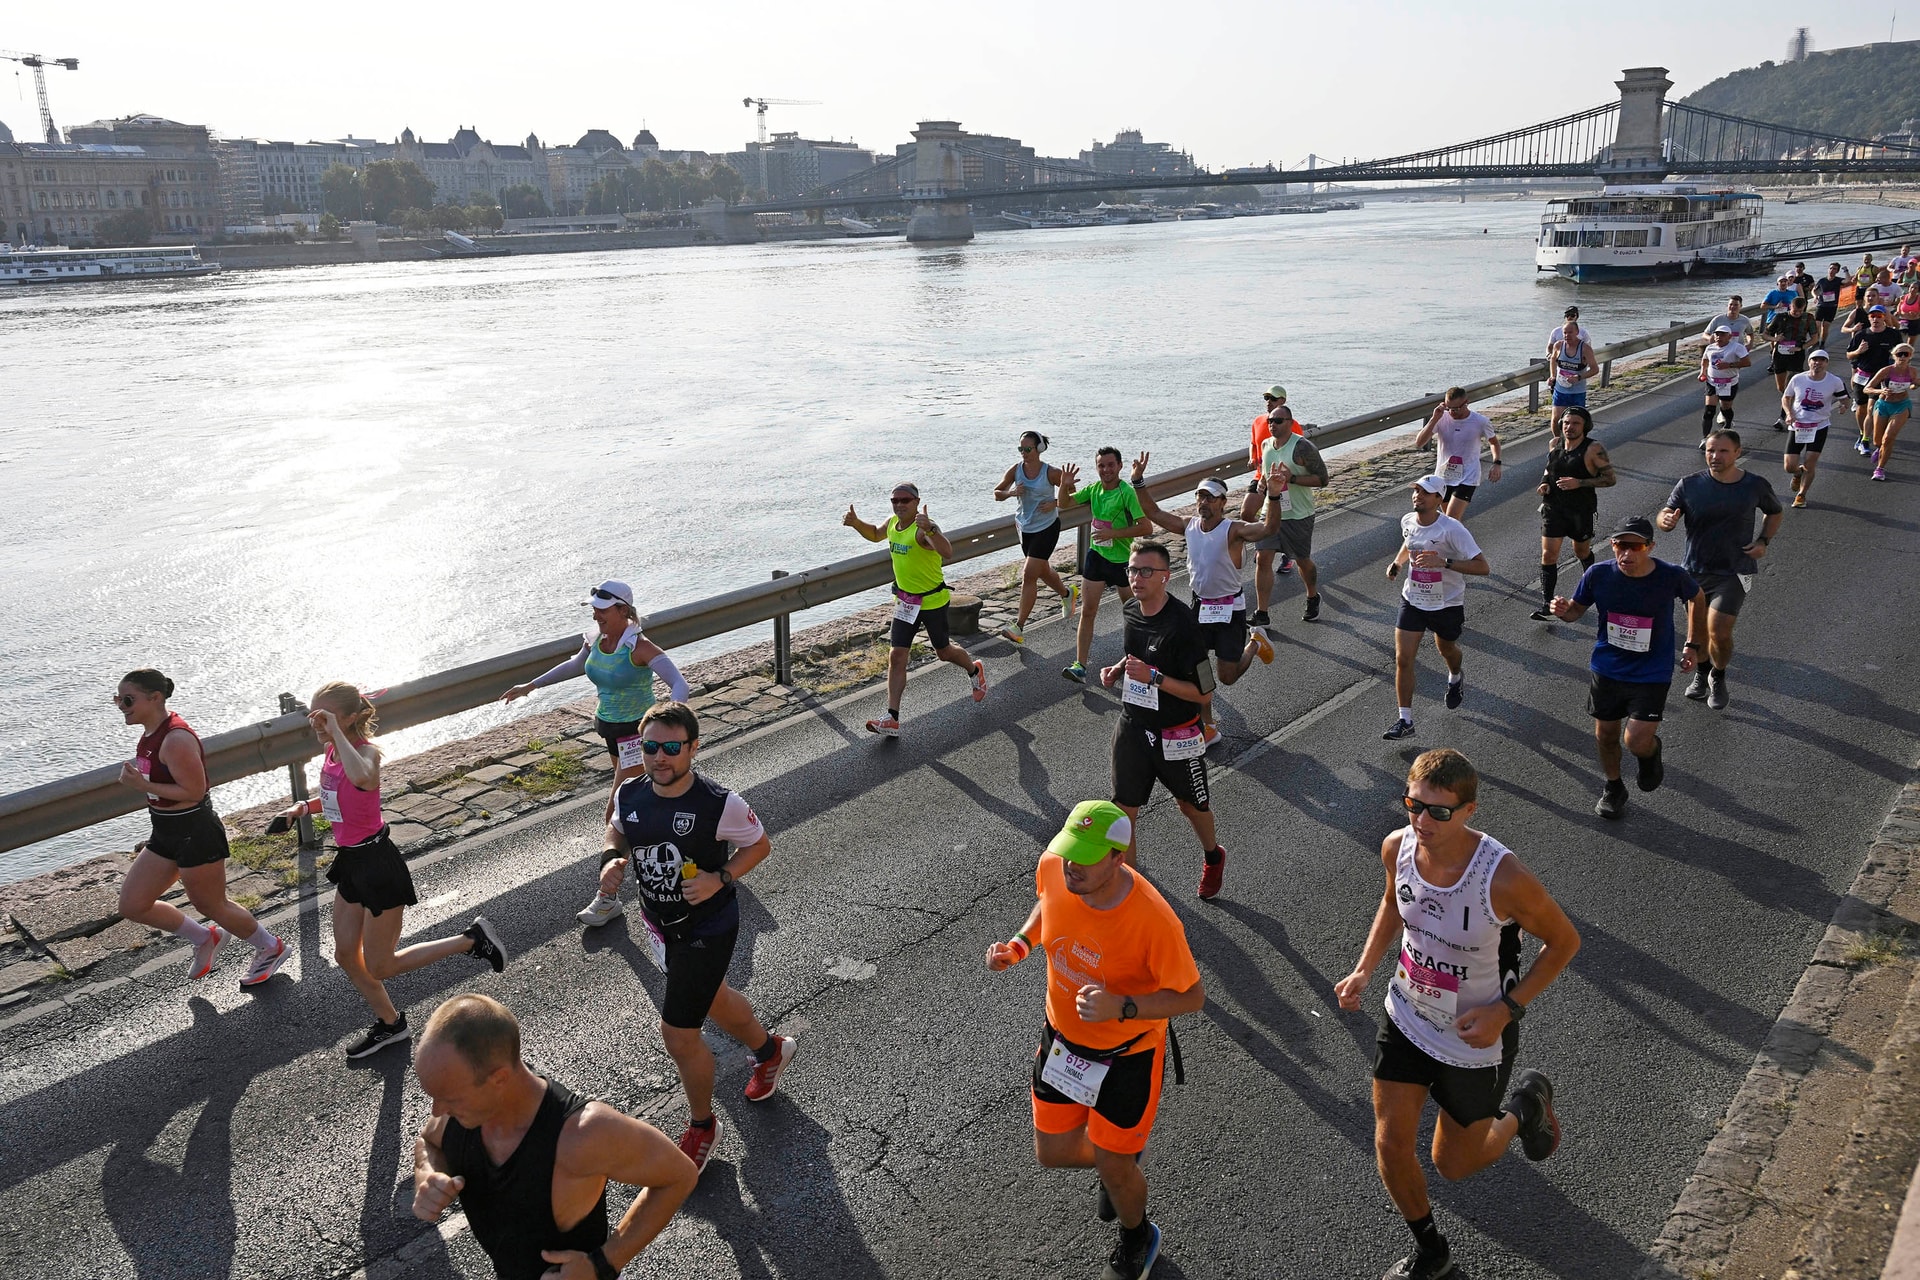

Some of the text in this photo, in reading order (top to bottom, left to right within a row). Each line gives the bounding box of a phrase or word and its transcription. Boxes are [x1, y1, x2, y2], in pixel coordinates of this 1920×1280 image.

[1618, 627, 1638, 636] 1745
[1129, 683, 1148, 695] 9256
[1176, 739, 1199, 749] 9256
[658, 893, 682, 902] BAU
[1428, 911, 1443, 921] SPACE
[1410, 925, 1480, 952] CHANNELS
[1408, 980, 1442, 999] 7939
[1066, 1054, 1092, 1072] 6127
[1063, 1065, 1084, 1081] THOMAS
